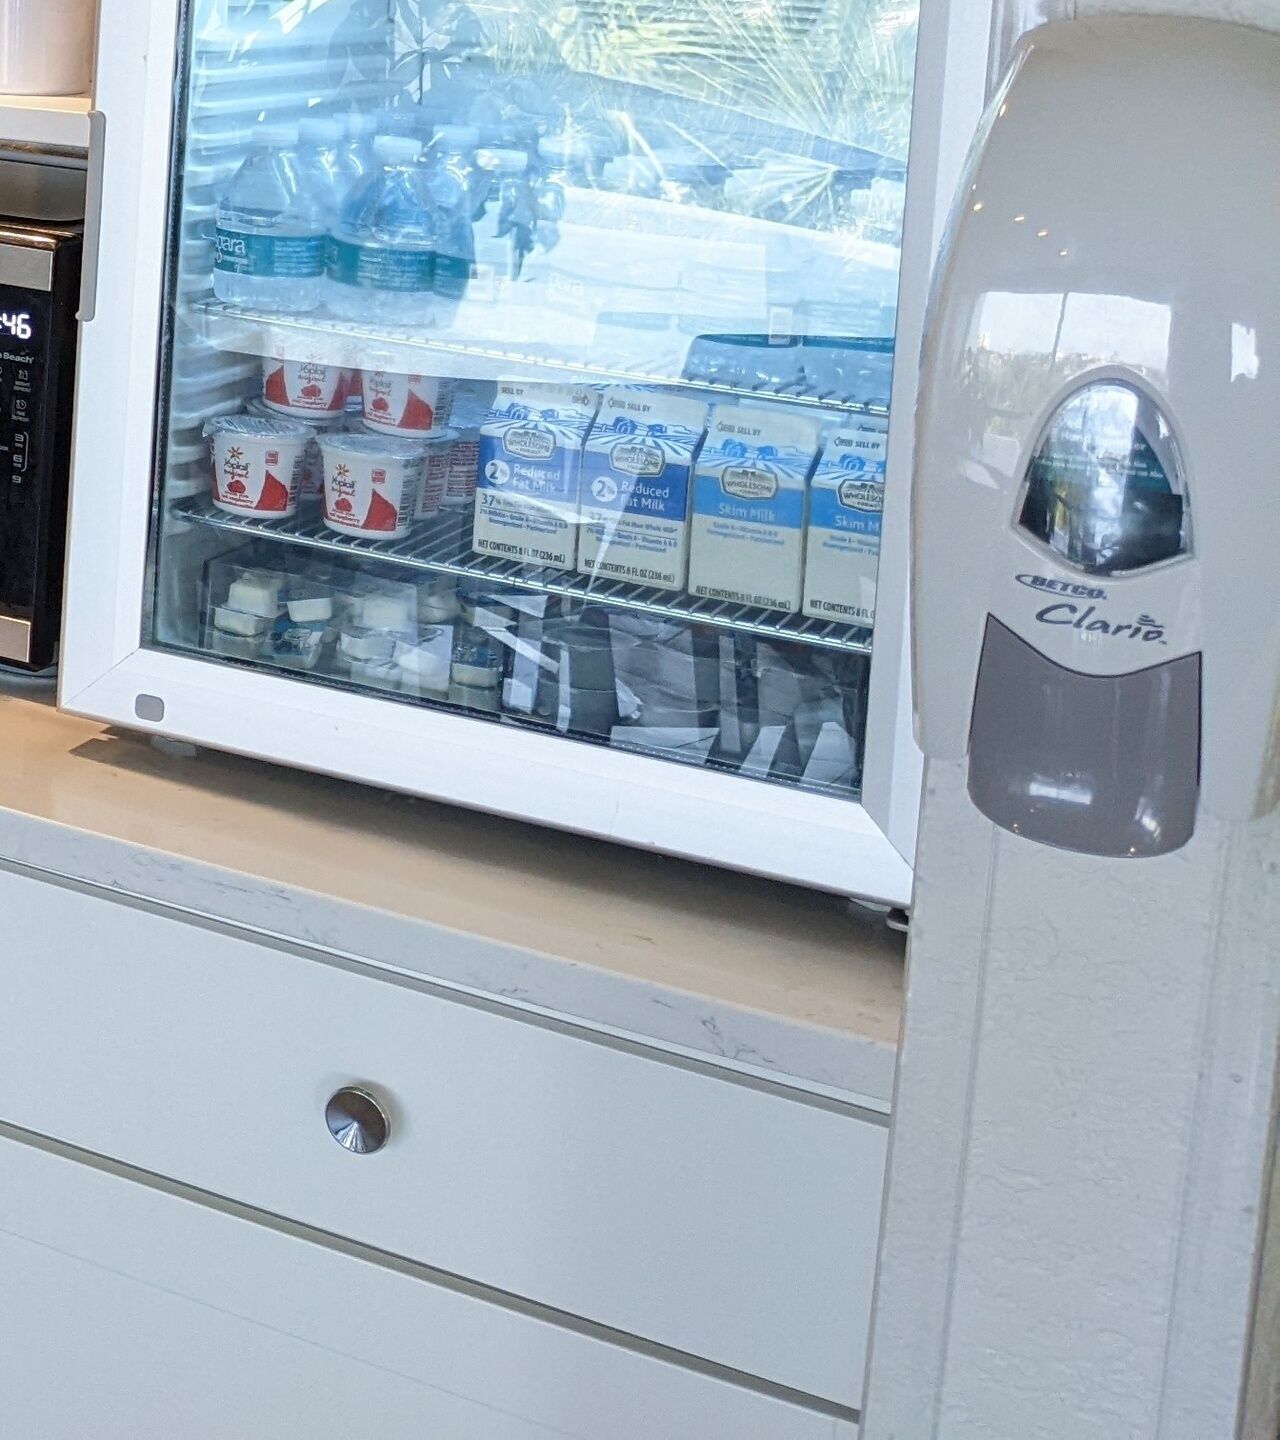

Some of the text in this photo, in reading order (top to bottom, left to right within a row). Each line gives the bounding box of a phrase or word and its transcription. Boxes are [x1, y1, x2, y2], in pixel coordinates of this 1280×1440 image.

[627, 402, 640, 411] SELL
[855, 441, 870, 449] SELL
[621, 481, 670, 498] Reduced
[641, 498, 665, 511] Milk
[719, 503, 776, 520] Skim Milk
[835, 515, 865, 530] Skim
[478, 539, 488, 549] NET
[489, 541, 517, 555] CONTENTS
[709, 587, 739, 600] CONTENTS
[810, 599, 822, 610] NET
[823, 602, 856, 617] CONTENTS
[861, 608, 870, 618] FL
[1035, 603, 1165, 643] Clario
